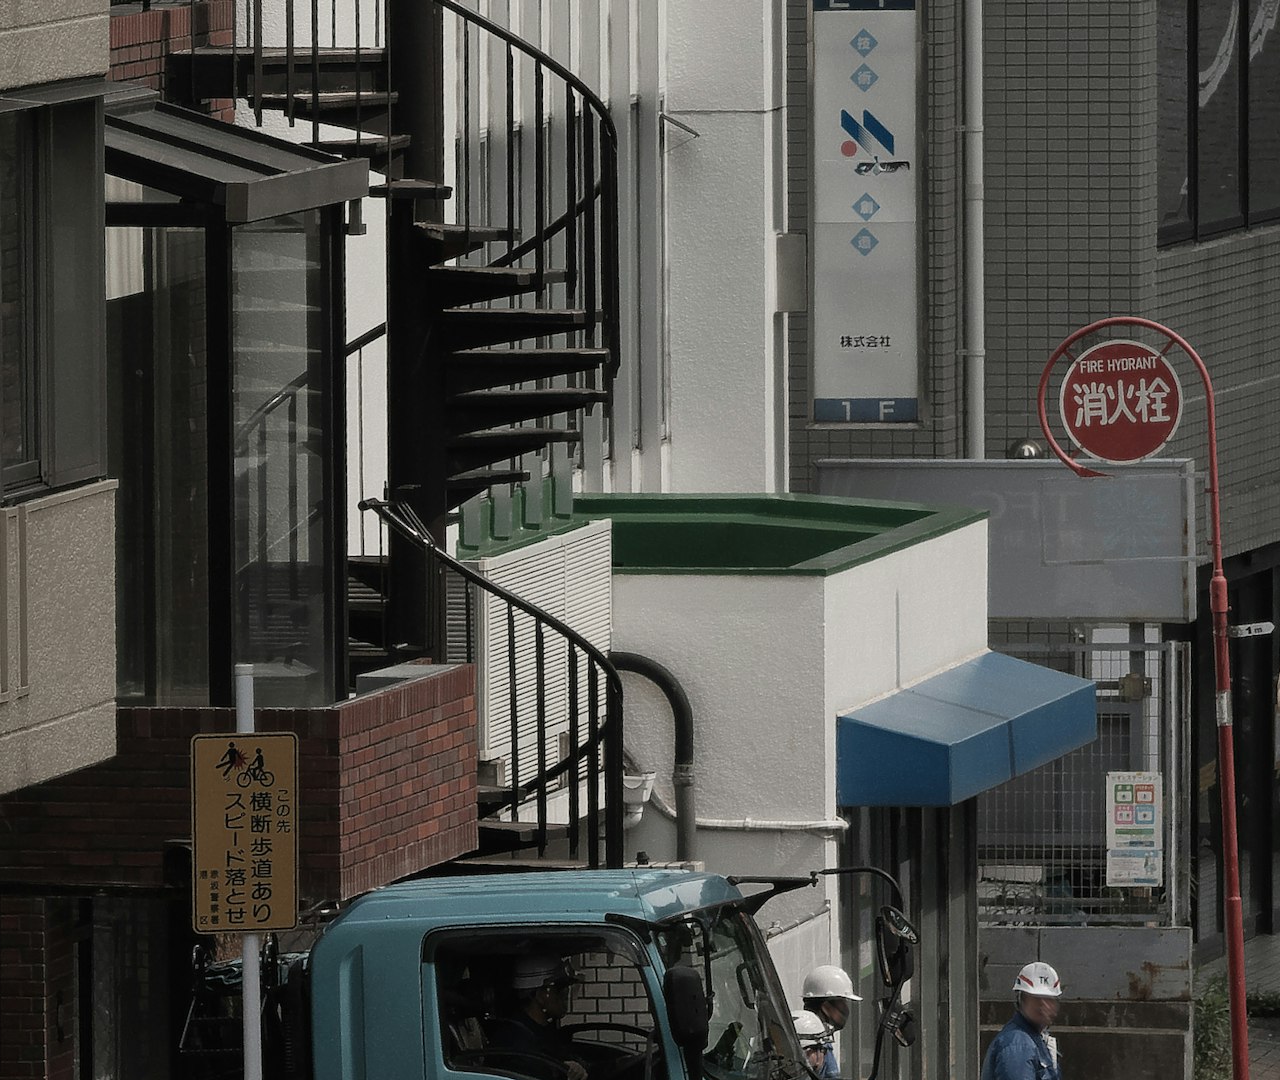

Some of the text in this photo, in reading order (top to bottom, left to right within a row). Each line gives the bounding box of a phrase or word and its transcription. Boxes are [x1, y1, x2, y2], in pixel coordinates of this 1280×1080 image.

[840, 335, 891, 348] 株式会社
[1080, 356, 1158, 373] FIRE HYDRANT
[1072, 376, 1171, 428] 消火栓
[277, 789, 290, 833] この先
[225, 793, 247, 923] スピード落とせ
[250, 792, 272, 923] 横断歩道あり
[1039, 976, 1049, 985] TK
